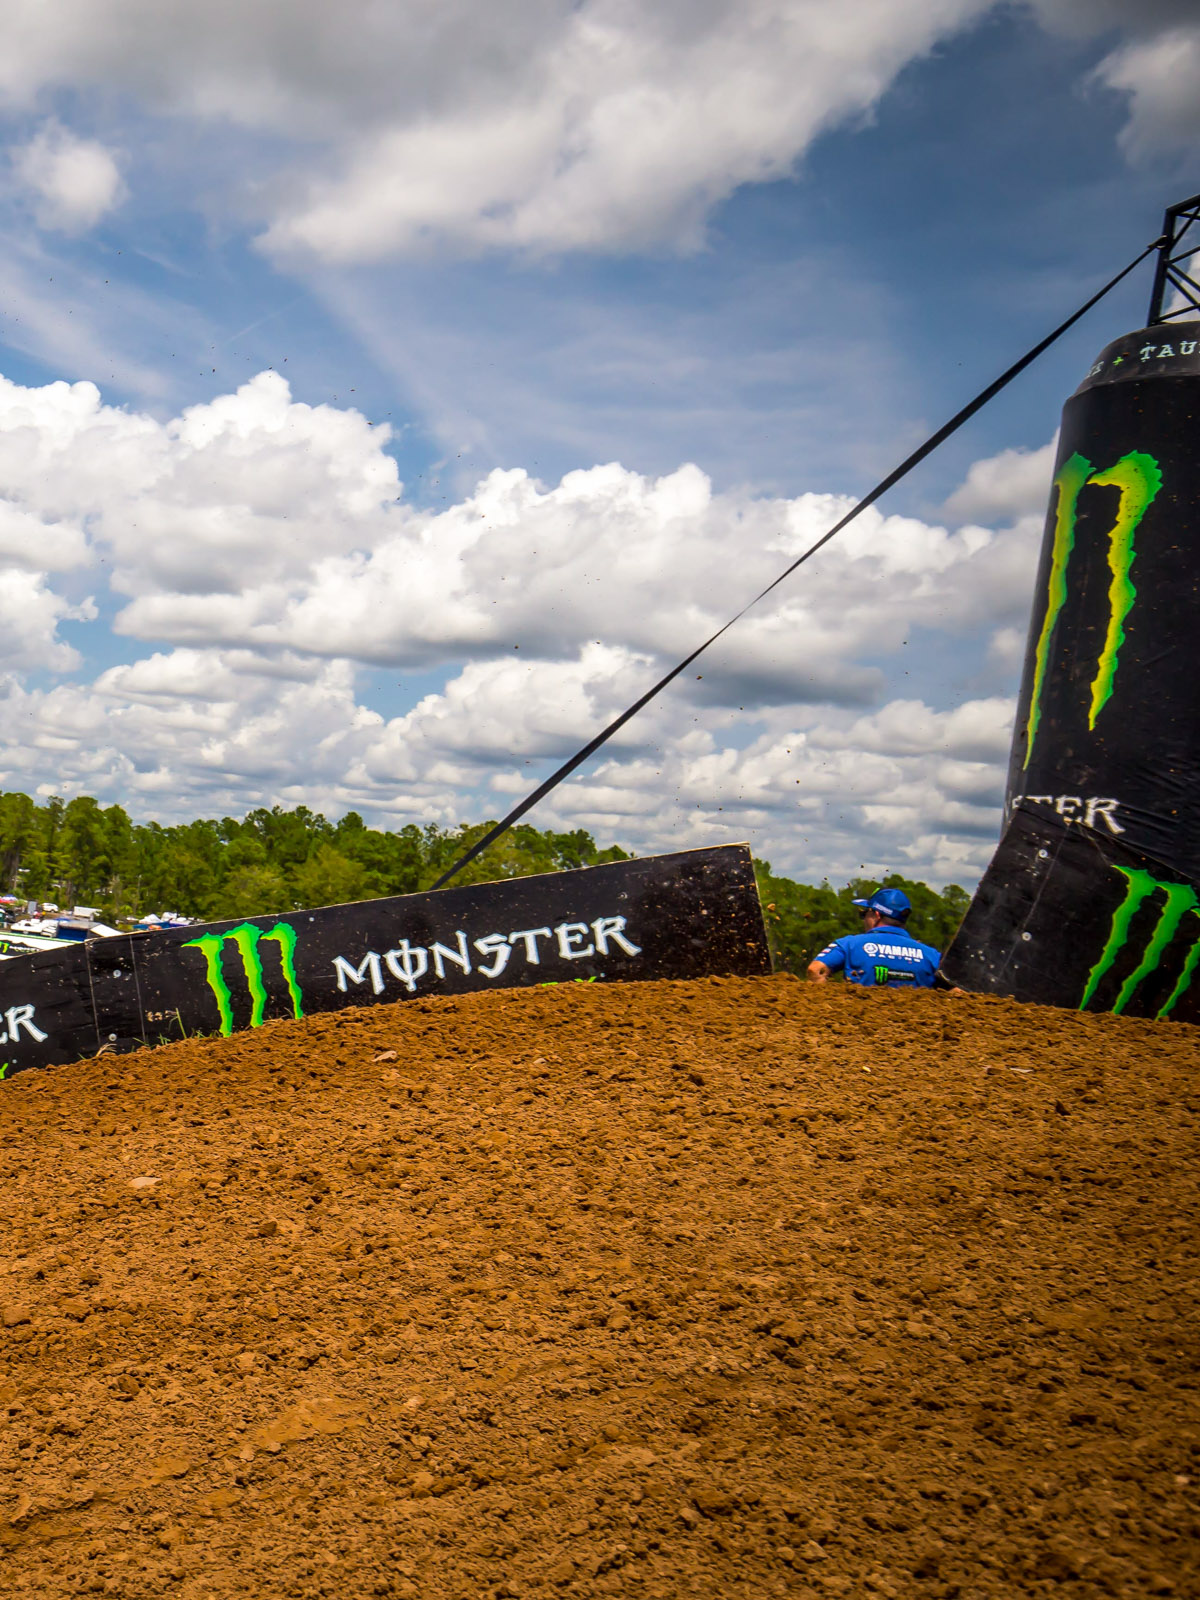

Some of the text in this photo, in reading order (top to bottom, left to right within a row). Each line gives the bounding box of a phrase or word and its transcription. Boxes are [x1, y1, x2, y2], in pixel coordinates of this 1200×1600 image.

[1139, 341, 1200, 362] TAU
[331, 915, 642, 995] MONSTER
[877, 944, 924, 959] YAMAHA
